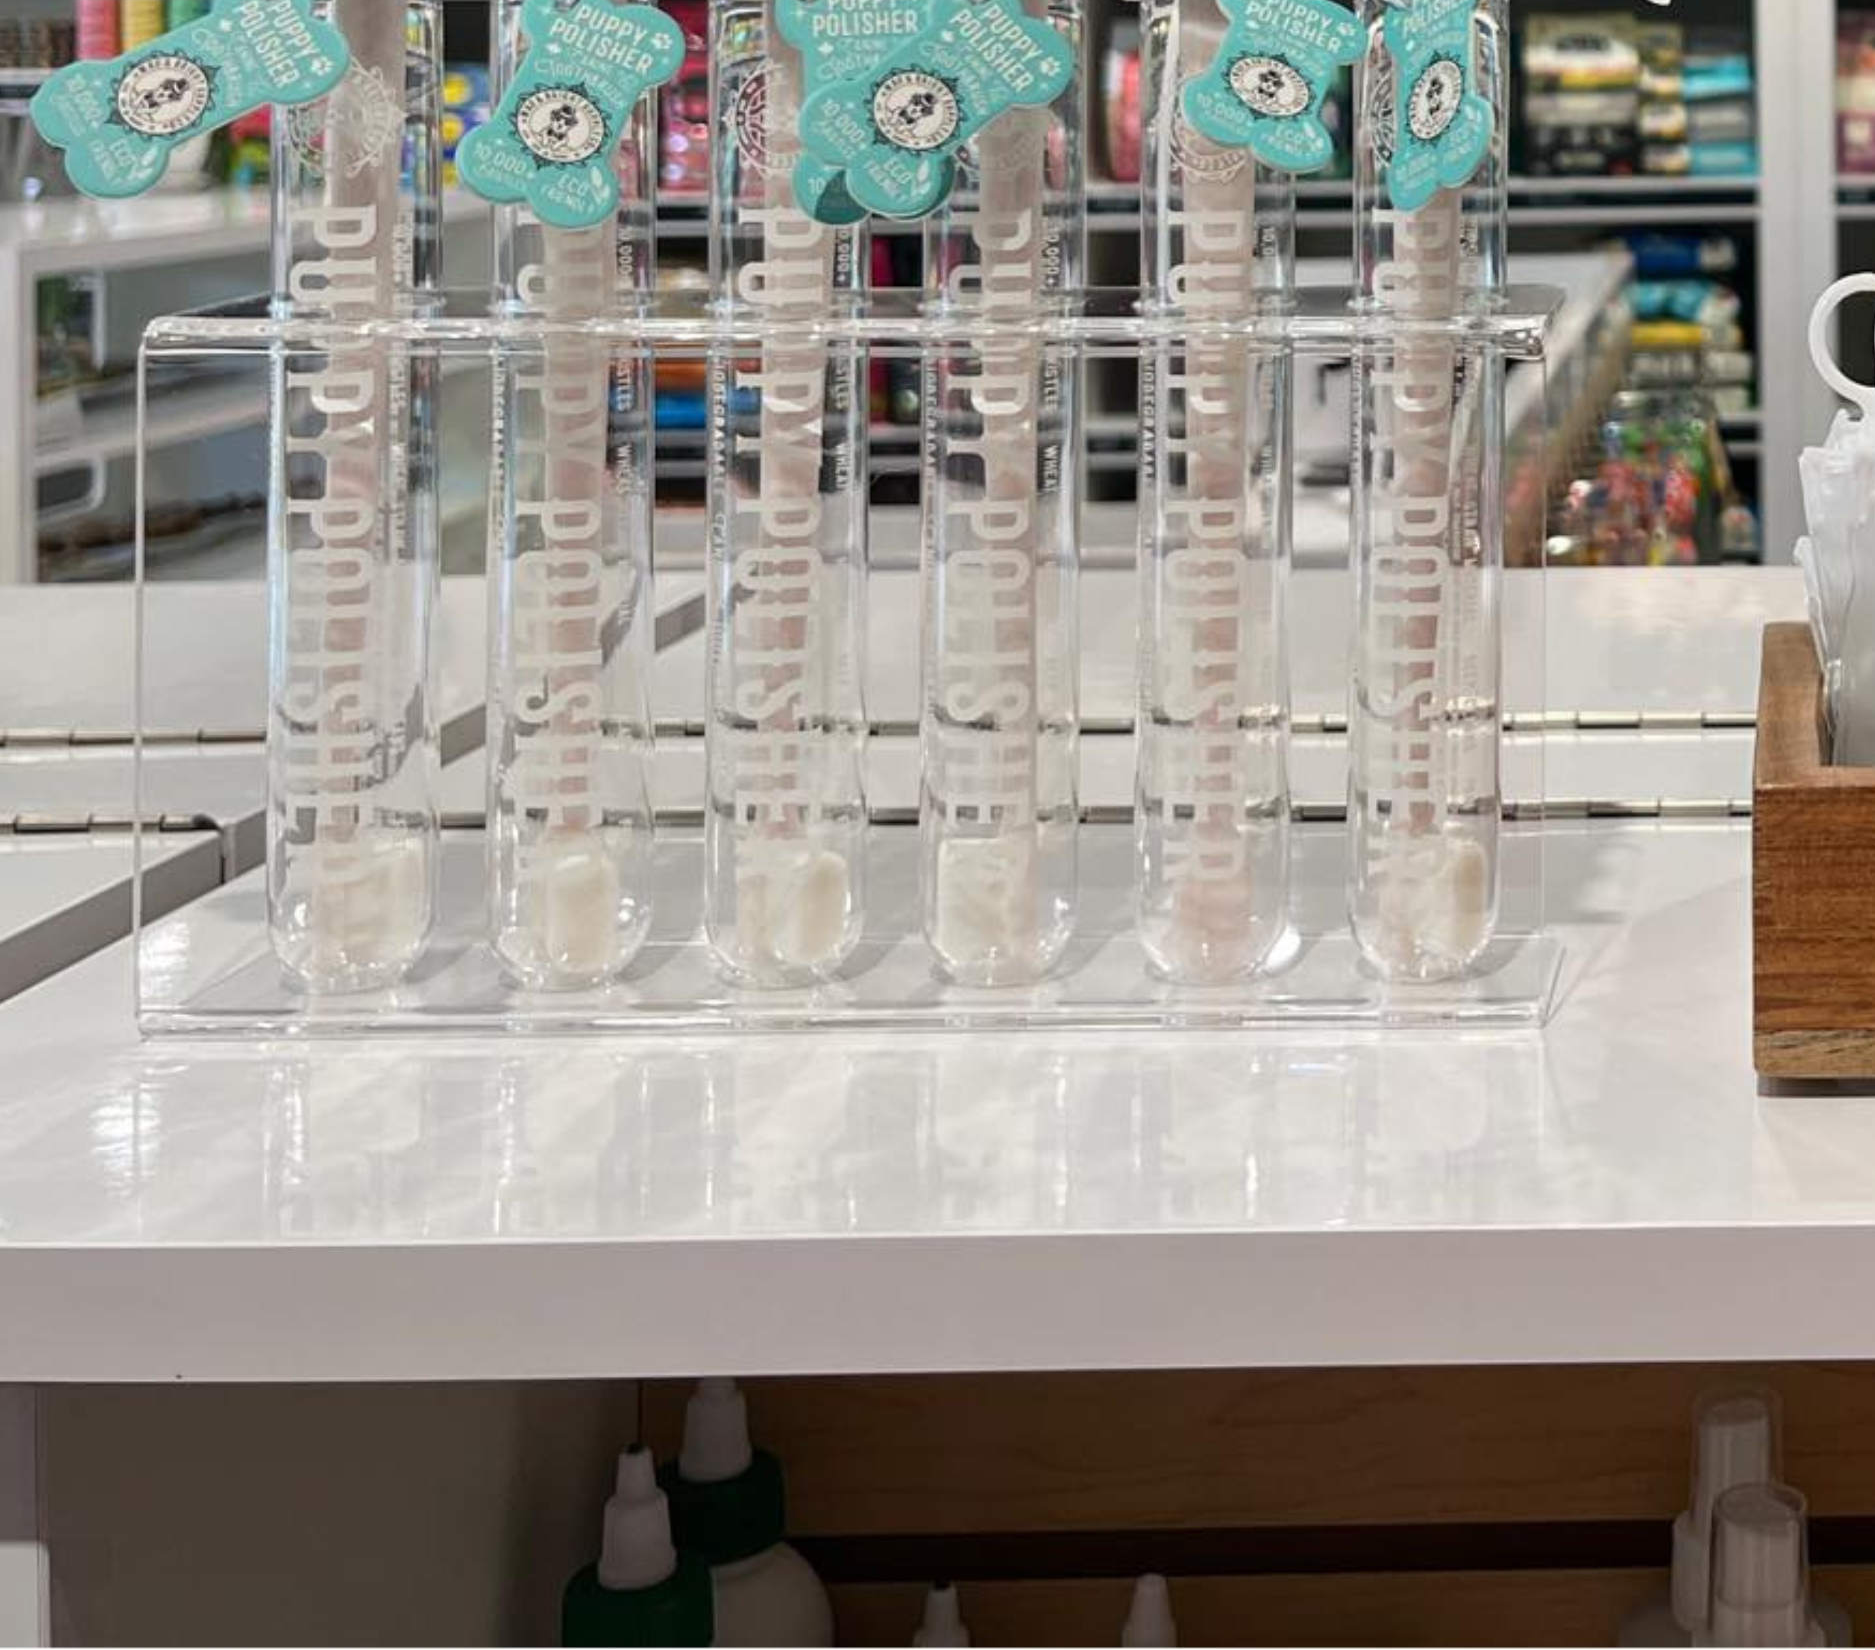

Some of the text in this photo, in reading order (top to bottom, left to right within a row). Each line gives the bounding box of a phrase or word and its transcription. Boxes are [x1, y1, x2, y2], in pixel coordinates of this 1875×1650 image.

[234, 0, 300, 88] POLISHER
[266, 0, 321, 58] PUPPY
[550, 18, 654, 75] POLISHER
[574, 5, 648, 46] PUPPY
[813, 10, 918, 37] POLISHER
[951, 9, 1034, 92] POLISHER
[982, 4, 1045, 60] PUPPY
[1245, 1, 1342, 53] POLISHER
[516, 207, 602, 464] UPY
[944, 500, 1033, 882] POLISHE
